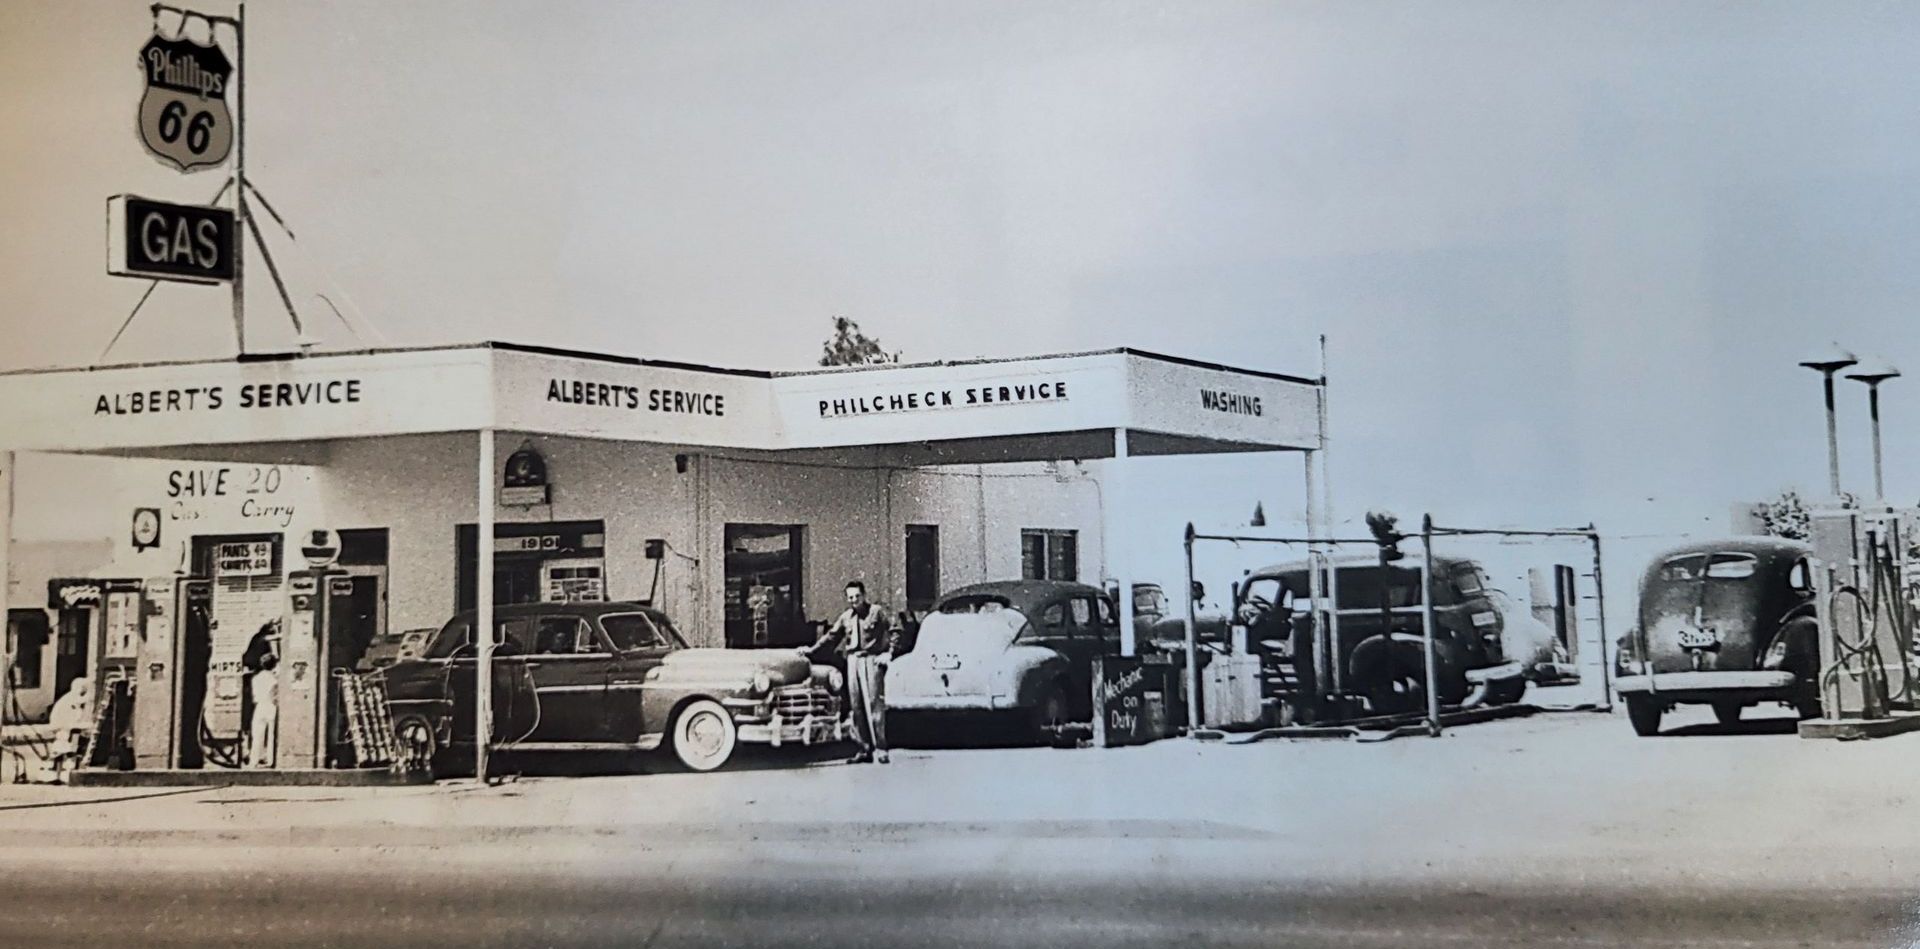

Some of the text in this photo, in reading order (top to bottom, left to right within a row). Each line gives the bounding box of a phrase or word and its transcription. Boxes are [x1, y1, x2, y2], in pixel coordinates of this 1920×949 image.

[148, 47, 223, 99] Phillips
[158, 100, 215, 155] 66
[141, 211, 219, 269] GAS
[94, 379, 361, 415] ALBERT'S SERVICE
[547, 378, 724, 417] ALBERT'S SERVICE
[819, 382, 1066, 416] PHILCHECK SERVICE
[1200, 389, 1262, 417] WASHING
[167, 468, 231, 498] SAVE
[1122, 696, 1139, 708] on
[1111, 709, 1138, 736] Duty
